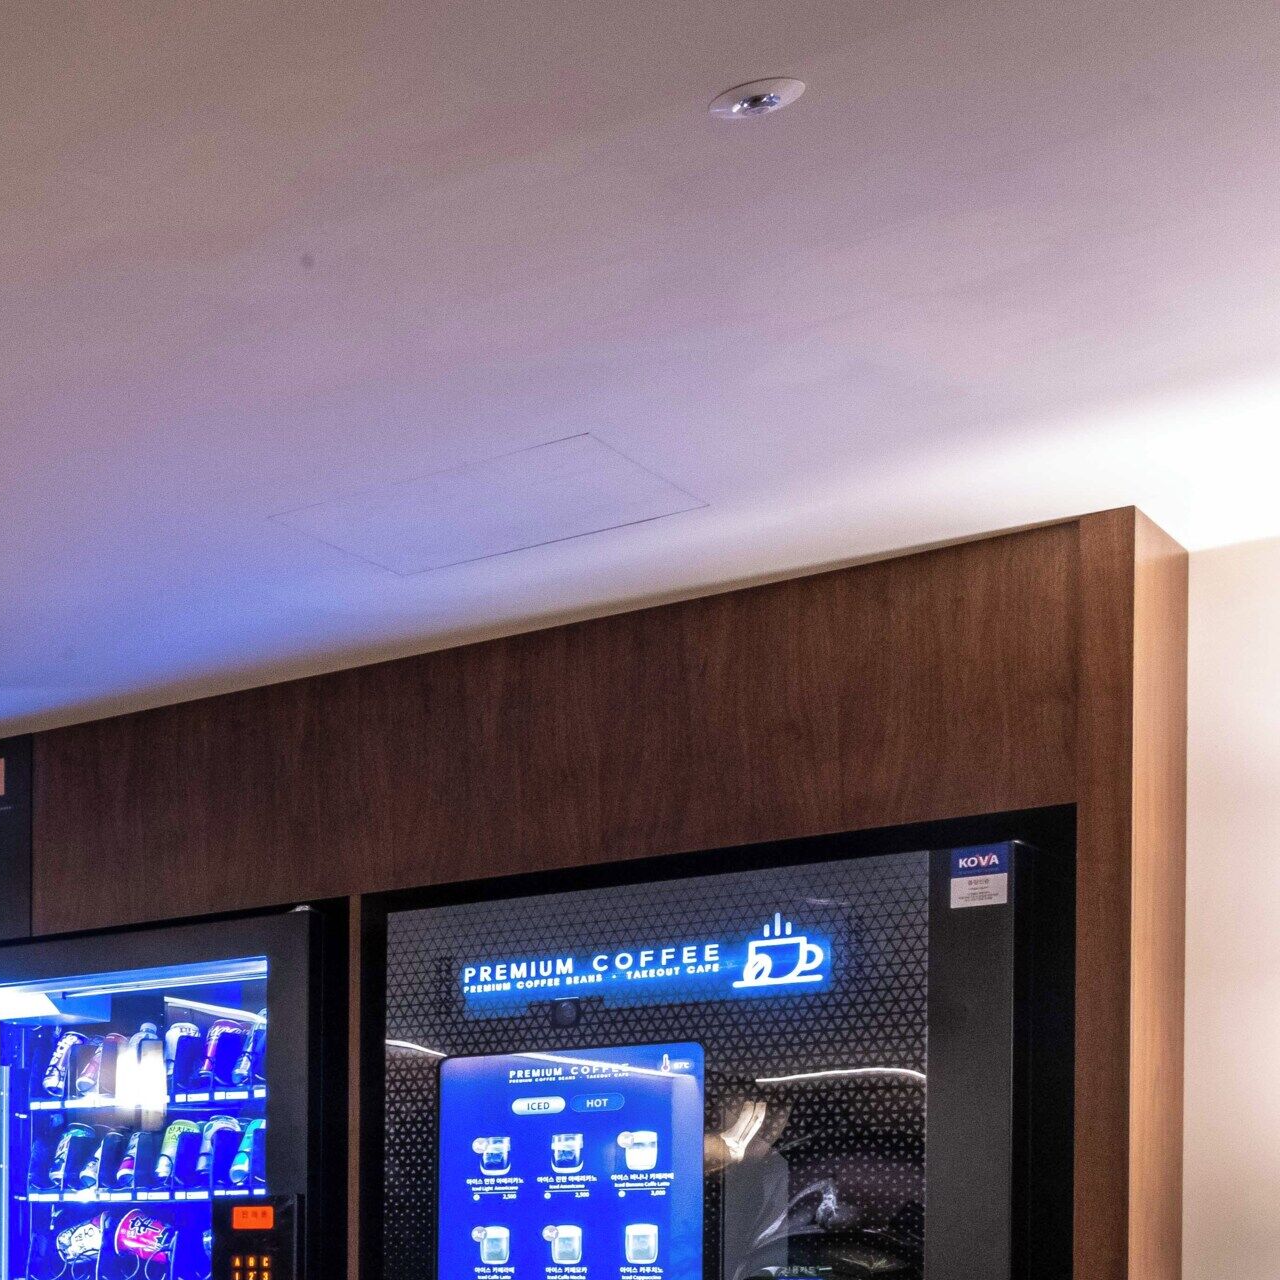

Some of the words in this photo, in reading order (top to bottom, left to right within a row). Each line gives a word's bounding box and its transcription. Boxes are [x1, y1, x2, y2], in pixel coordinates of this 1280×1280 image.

[958, 854, 999, 868] KOVA
[464, 958, 573, 983] PREMIUM
[593, 944, 719, 972] COFFEE
[464, 983, 511, 994] PREMIUM
[517, 978, 560, 989] COFFEE
[566, 974, 602, 985] BEANS
[626, 967, 680, 980] TAKEOUT
[687, 963, 720, 974] CAFE
[509, 1067, 562, 1078] PREMIUM
[527, 1102, 550, 1110] ICED
[586, 1098, 608, 1107] HOT
[234, 1257, 240, 1267] A
[263, 1257, 268, 1267] C
[249, 1272, 254, 1280] 2
[263, 1272, 268, 1280] 3
